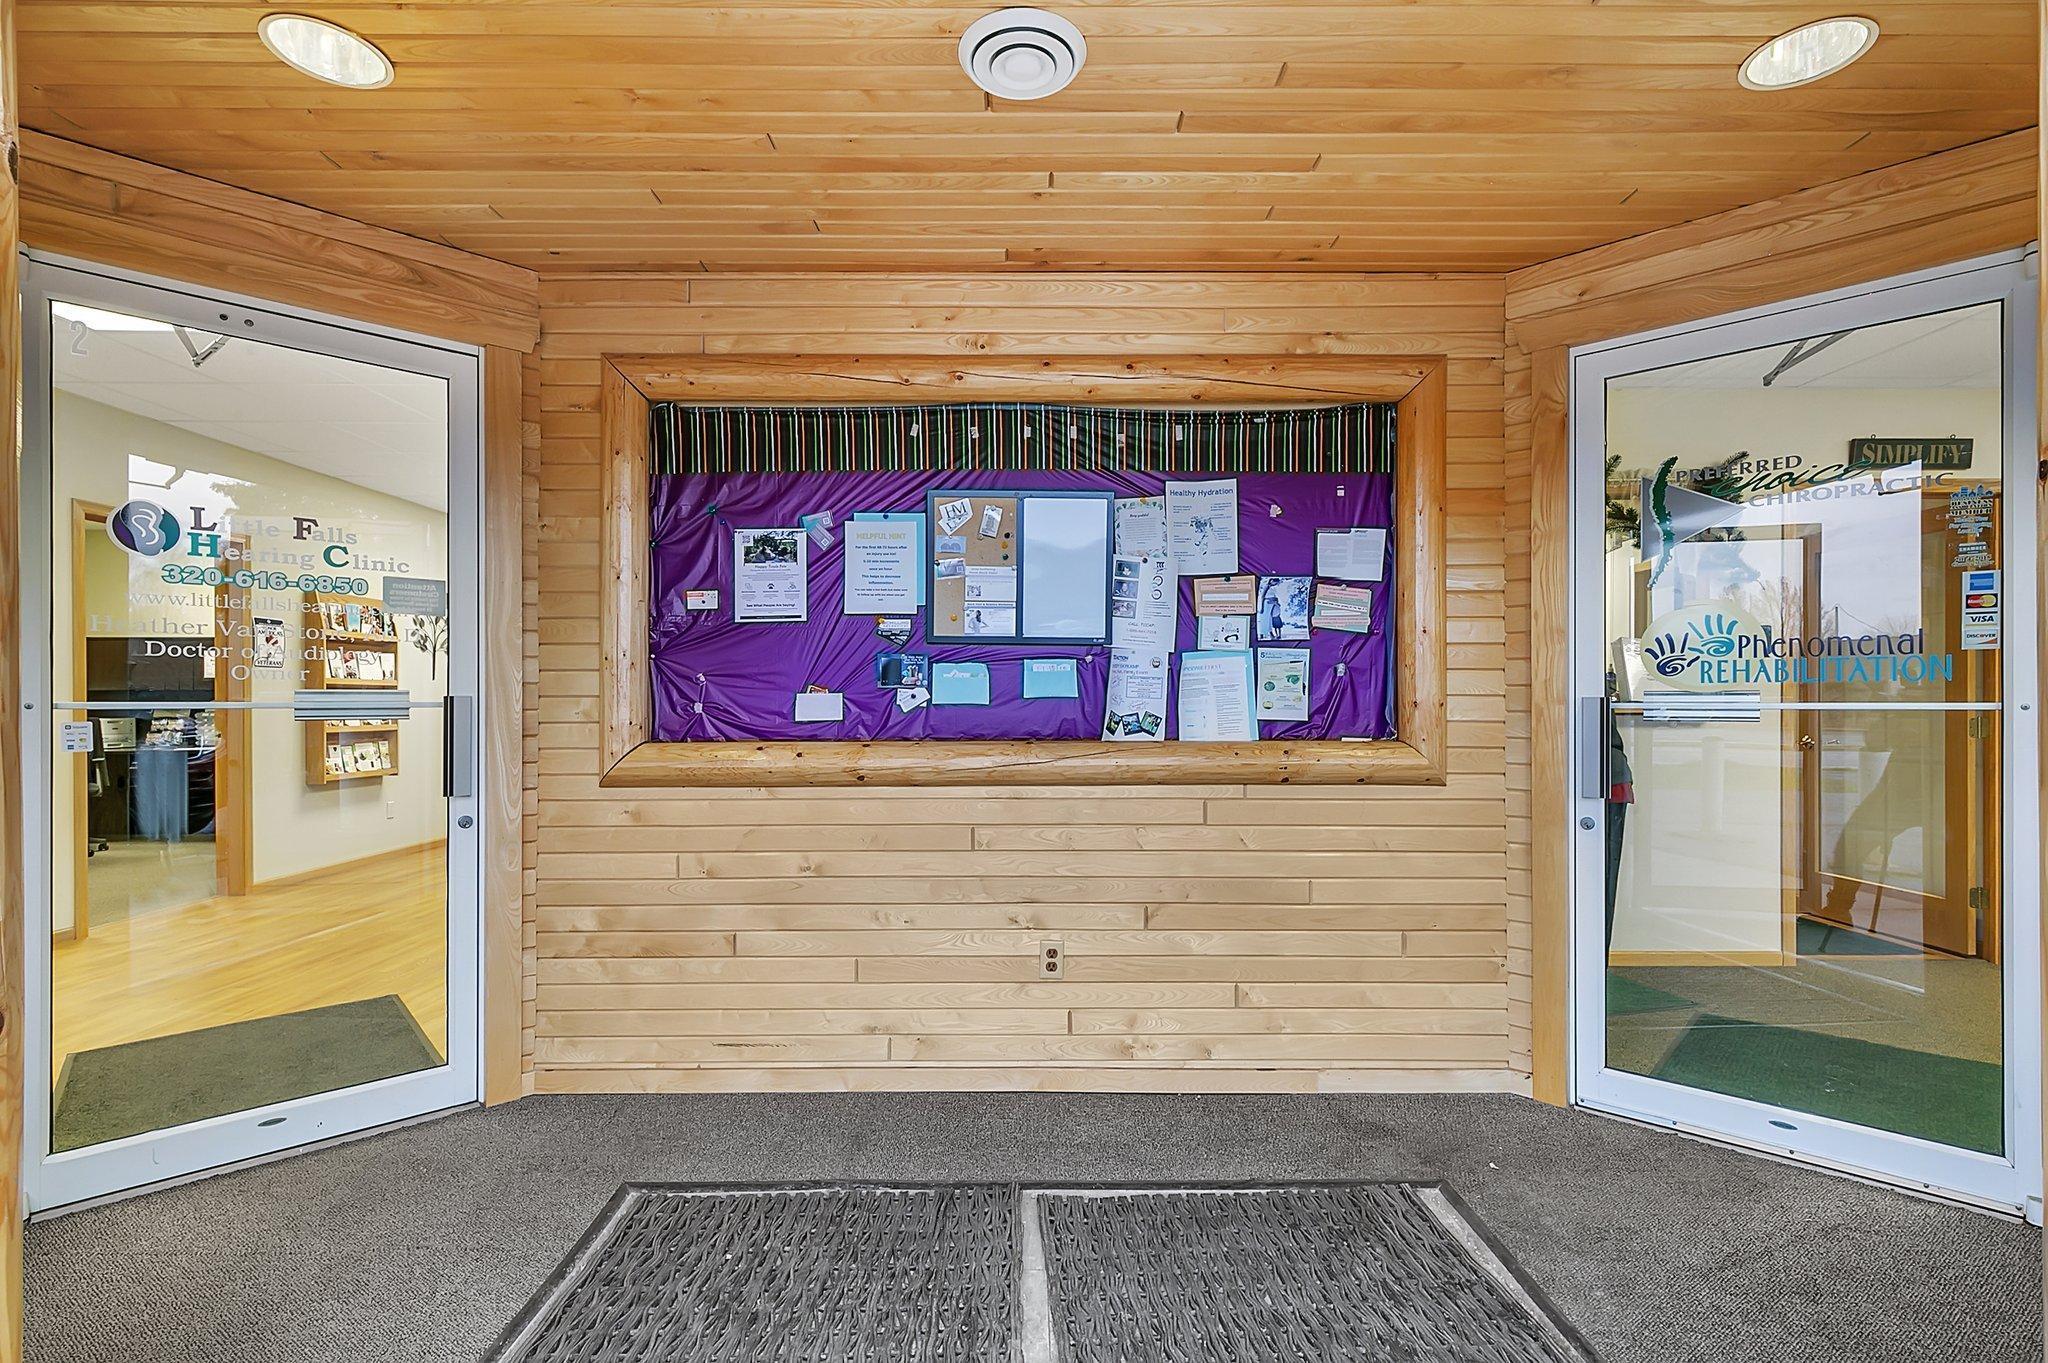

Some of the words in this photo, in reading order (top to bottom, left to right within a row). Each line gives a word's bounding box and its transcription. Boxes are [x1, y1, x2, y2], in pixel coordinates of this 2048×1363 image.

[69, 320, 89, 358] 2
[1861, 443, 1965, 464] SIMPLIFY
[1676, 455, 1803, 483] PREFERRED
[1170, 489, 1196, 498] Healthy
[1198, 488, 1233, 498] Hydration
[1750, 472, 1953, 507] CHIROPRACTIC
[189, 506, 280, 537] Little
[292, 516, 358, 545] Falls
[856, 532, 888, 540] HELPFUL
[889, 532, 907, 540] HINT
[186, 532, 315, 571] Hearing
[322, 544, 410, 574] Clinic
[161, 563, 369, 595] 320-616-6850
[90, 613, 208, 635] Heather
[145, 640, 233, 659] Doctor
[273, 645, 380, 665] Audiology
[1738, 628, 1924, 659] Phenomenal
[231, 664, 310, 681] Owner
[1700, 653, 1953, 684] REHABILITATION
